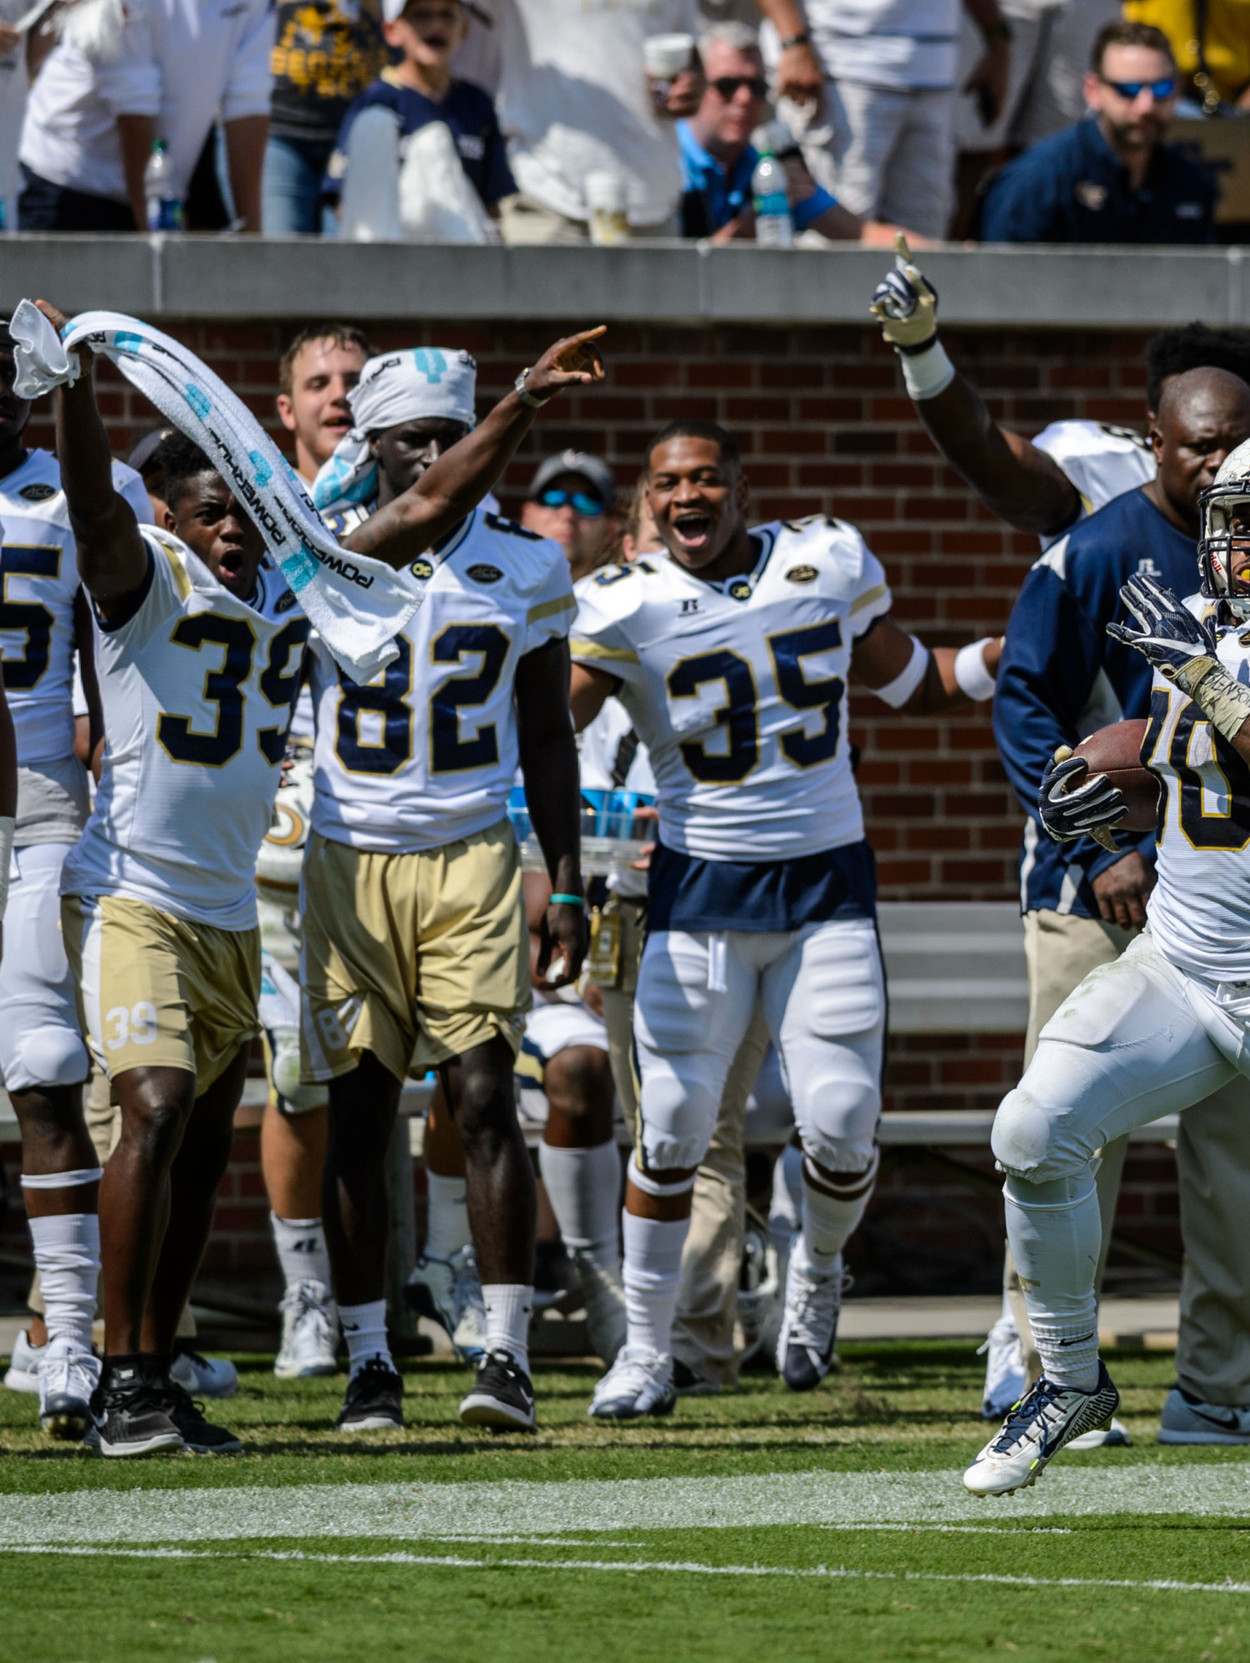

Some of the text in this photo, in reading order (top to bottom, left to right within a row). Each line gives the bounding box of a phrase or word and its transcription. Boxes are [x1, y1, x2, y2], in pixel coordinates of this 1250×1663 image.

[274, 495, 376, 589] POWE
[155, 609, 312, 769] 39
[334, 621, 511, 776] 82
[666, 618, 847, 786] 35
[105, 1001, 158, 1050] 39
